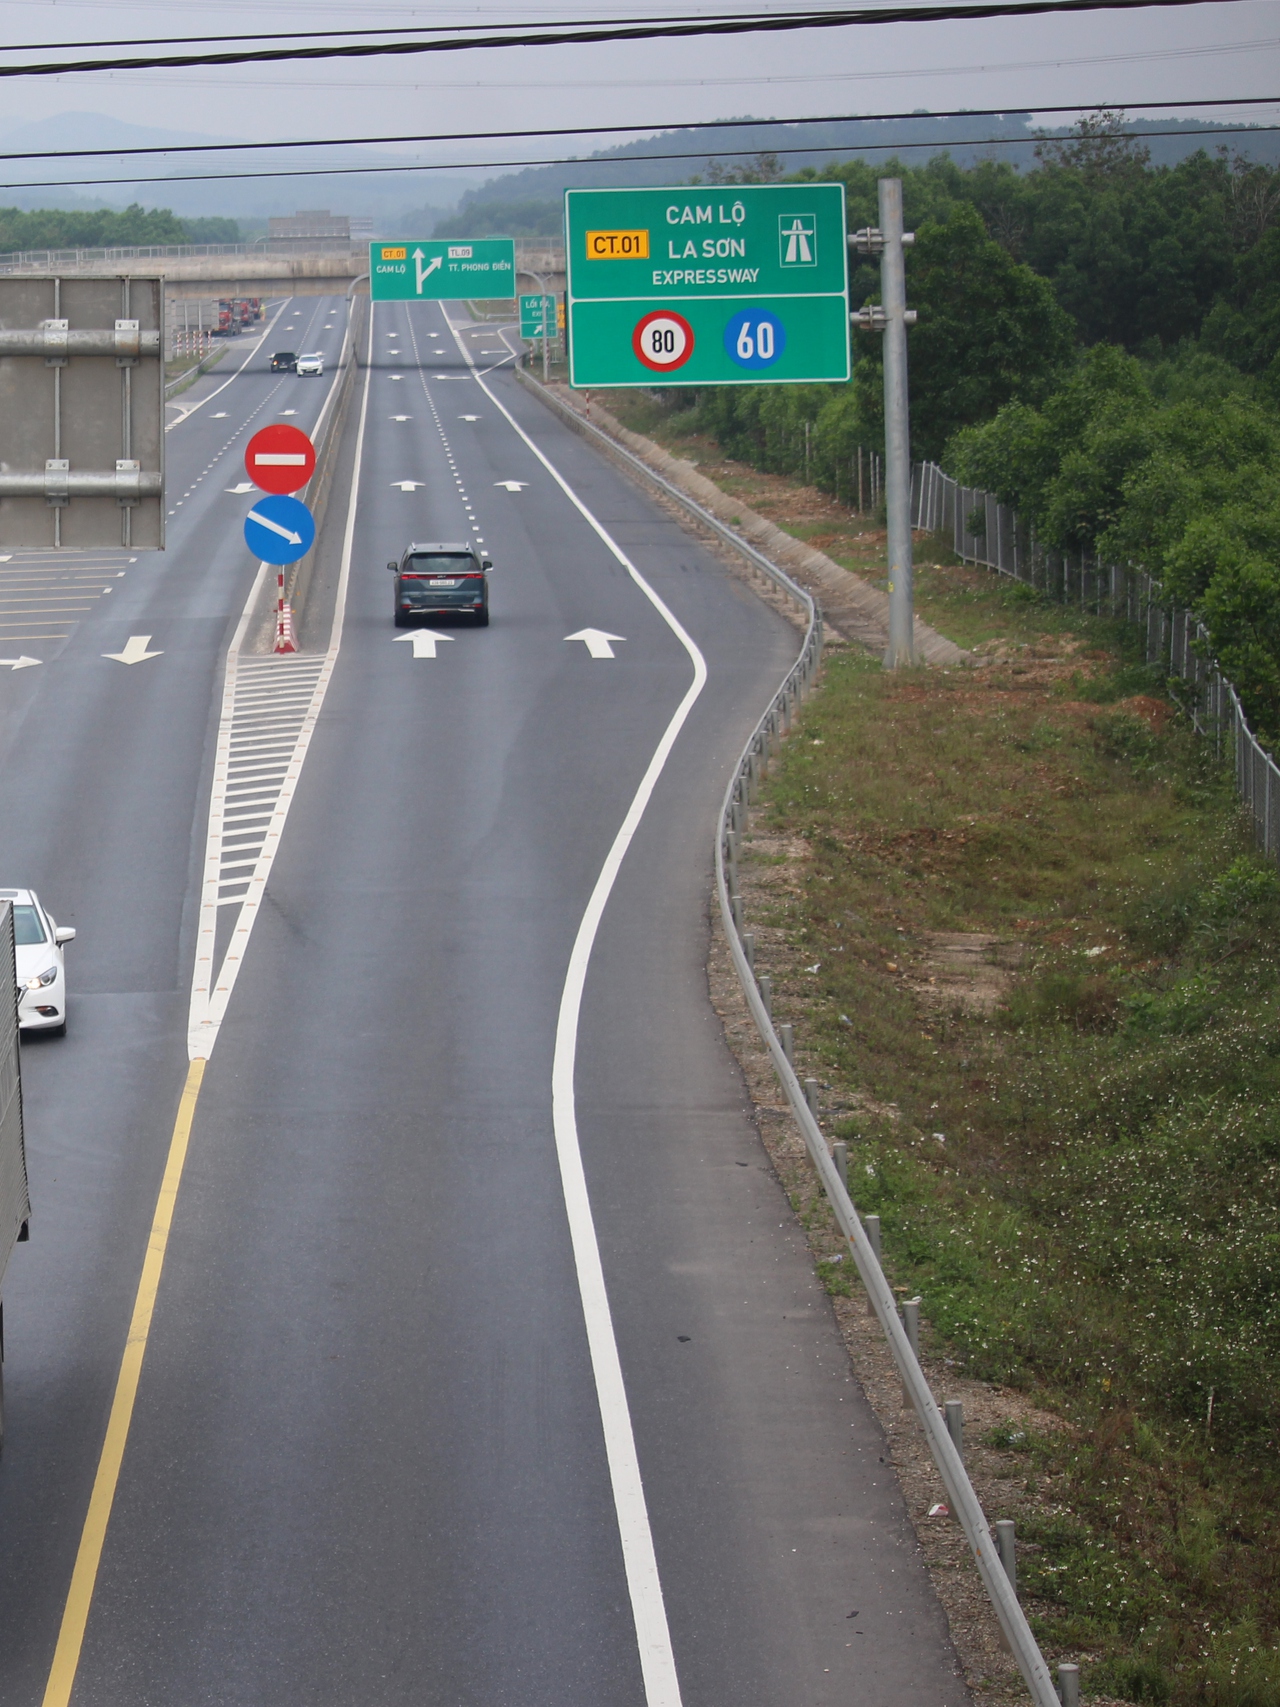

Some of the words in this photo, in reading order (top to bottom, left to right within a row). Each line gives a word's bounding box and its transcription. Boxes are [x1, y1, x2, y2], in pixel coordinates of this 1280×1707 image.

[666, 205, 713, 225] CAM
[719, 201, 746, 227] LỘ
[383, 250, 404, 258] CT.01
[593, 236, 640, 254] CT.01
[668, 240, 698, 259] LA
[702, 238, 746, 259] SƠN
[376, 265, 394, 274] CAM
[395, 263, 406, 275] LỘ
[461, 262, 490, 272] PHONG
[652, 268, 760, 285] EXPRESSWAY
[651, 329, 675, 353] 80
[736, 321, 775, 359] 60
